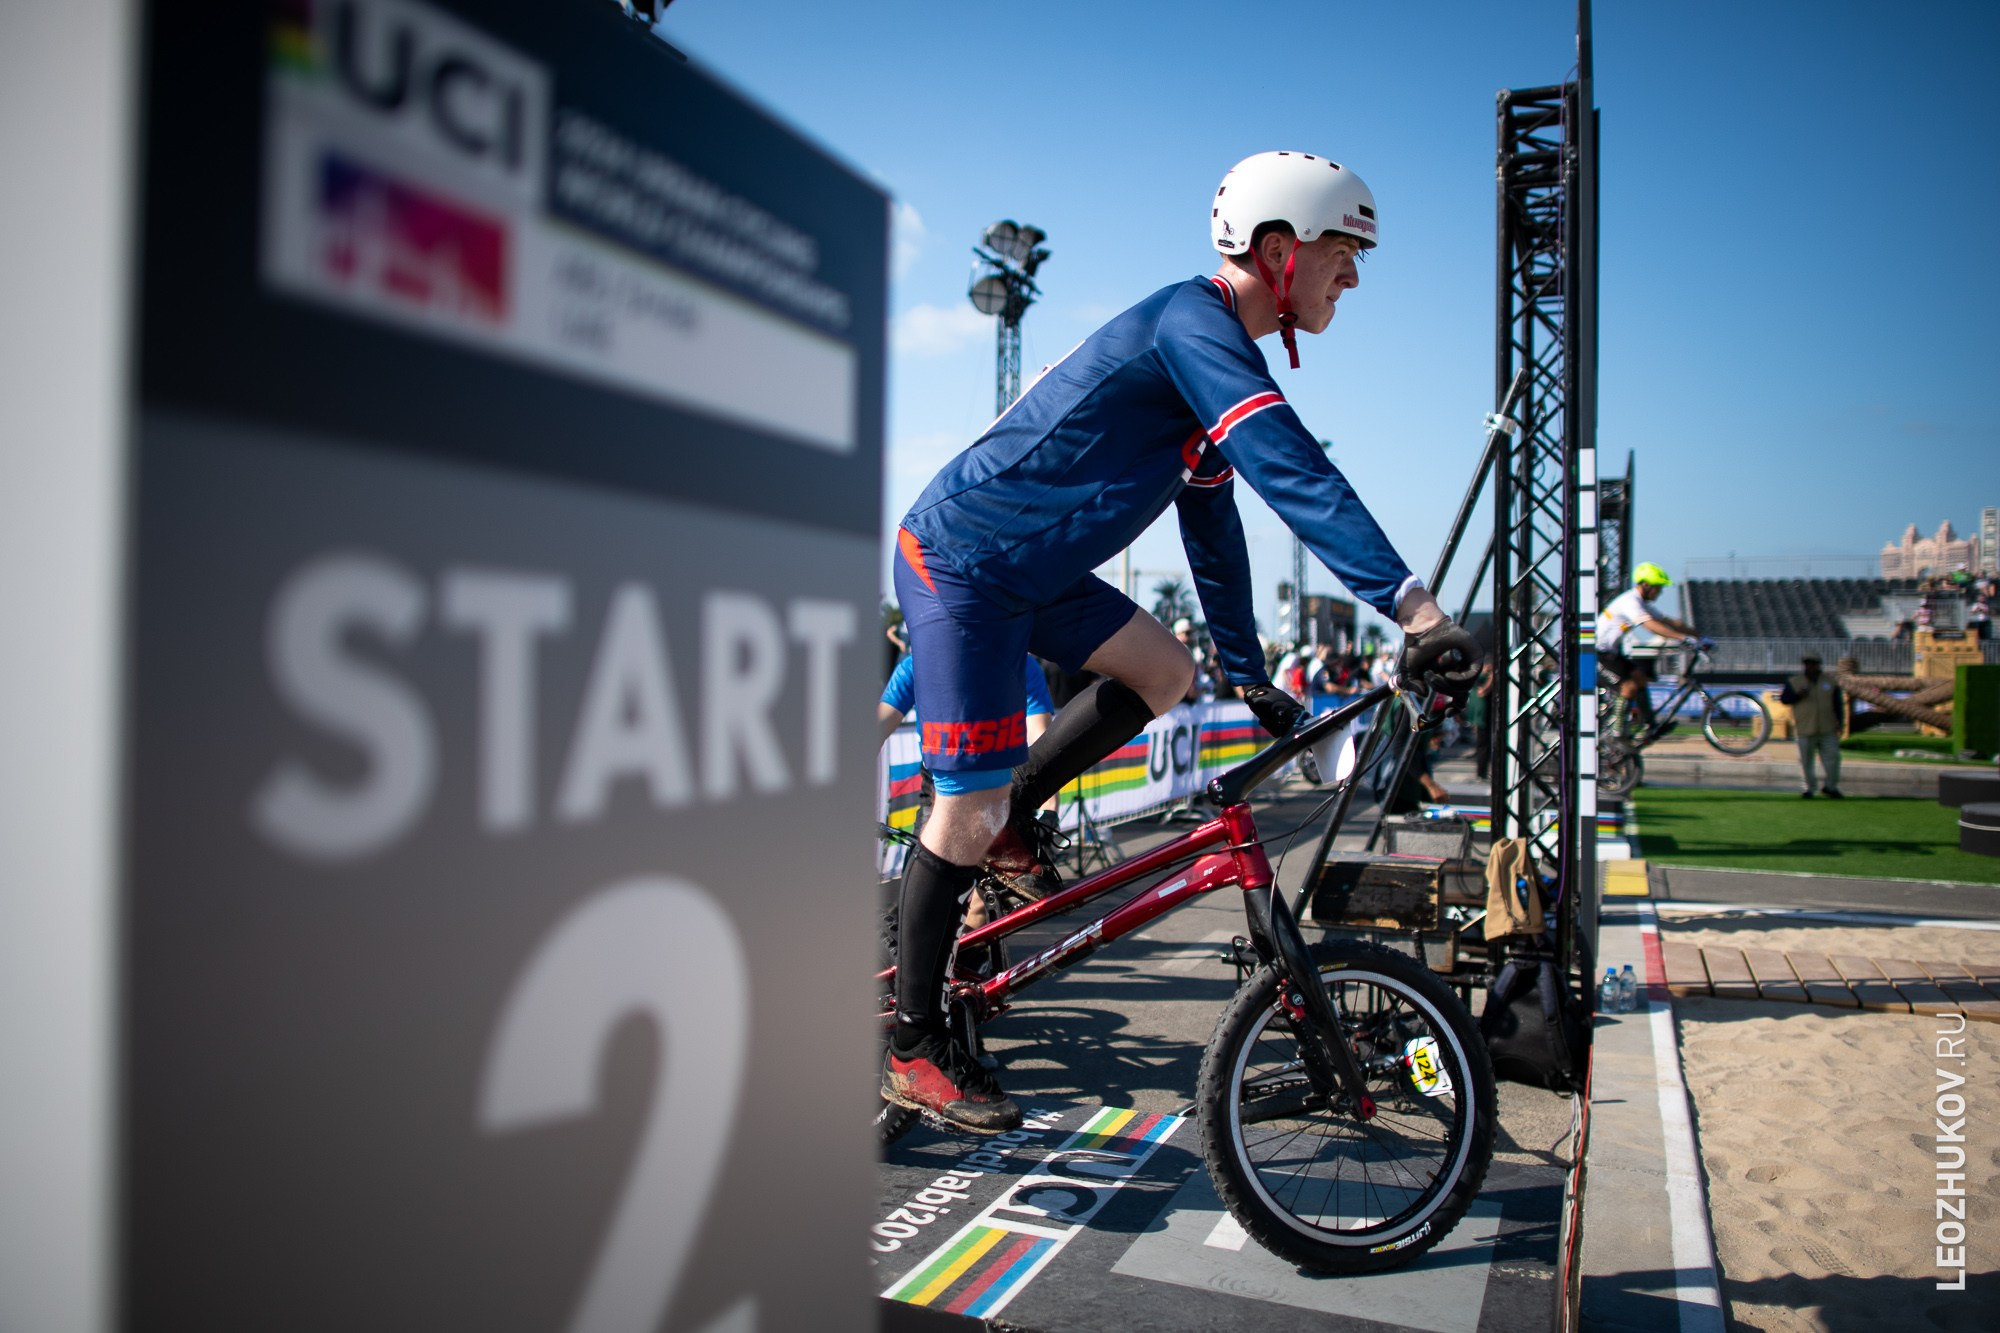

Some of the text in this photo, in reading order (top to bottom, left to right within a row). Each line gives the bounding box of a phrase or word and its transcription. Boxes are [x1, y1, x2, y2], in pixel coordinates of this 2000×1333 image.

[328, 0, 526, 178] UCI
[252, 551, 858, 860] START
[1149, 723, 1199, 782] UCI
[478, 874, 757, 1333] 2
[1416, 1052, 1437, 1082] 124
[867, 1108, 1064, 1266] #Abudhabi202
[988, 1152, 1138, 1231] UCI
